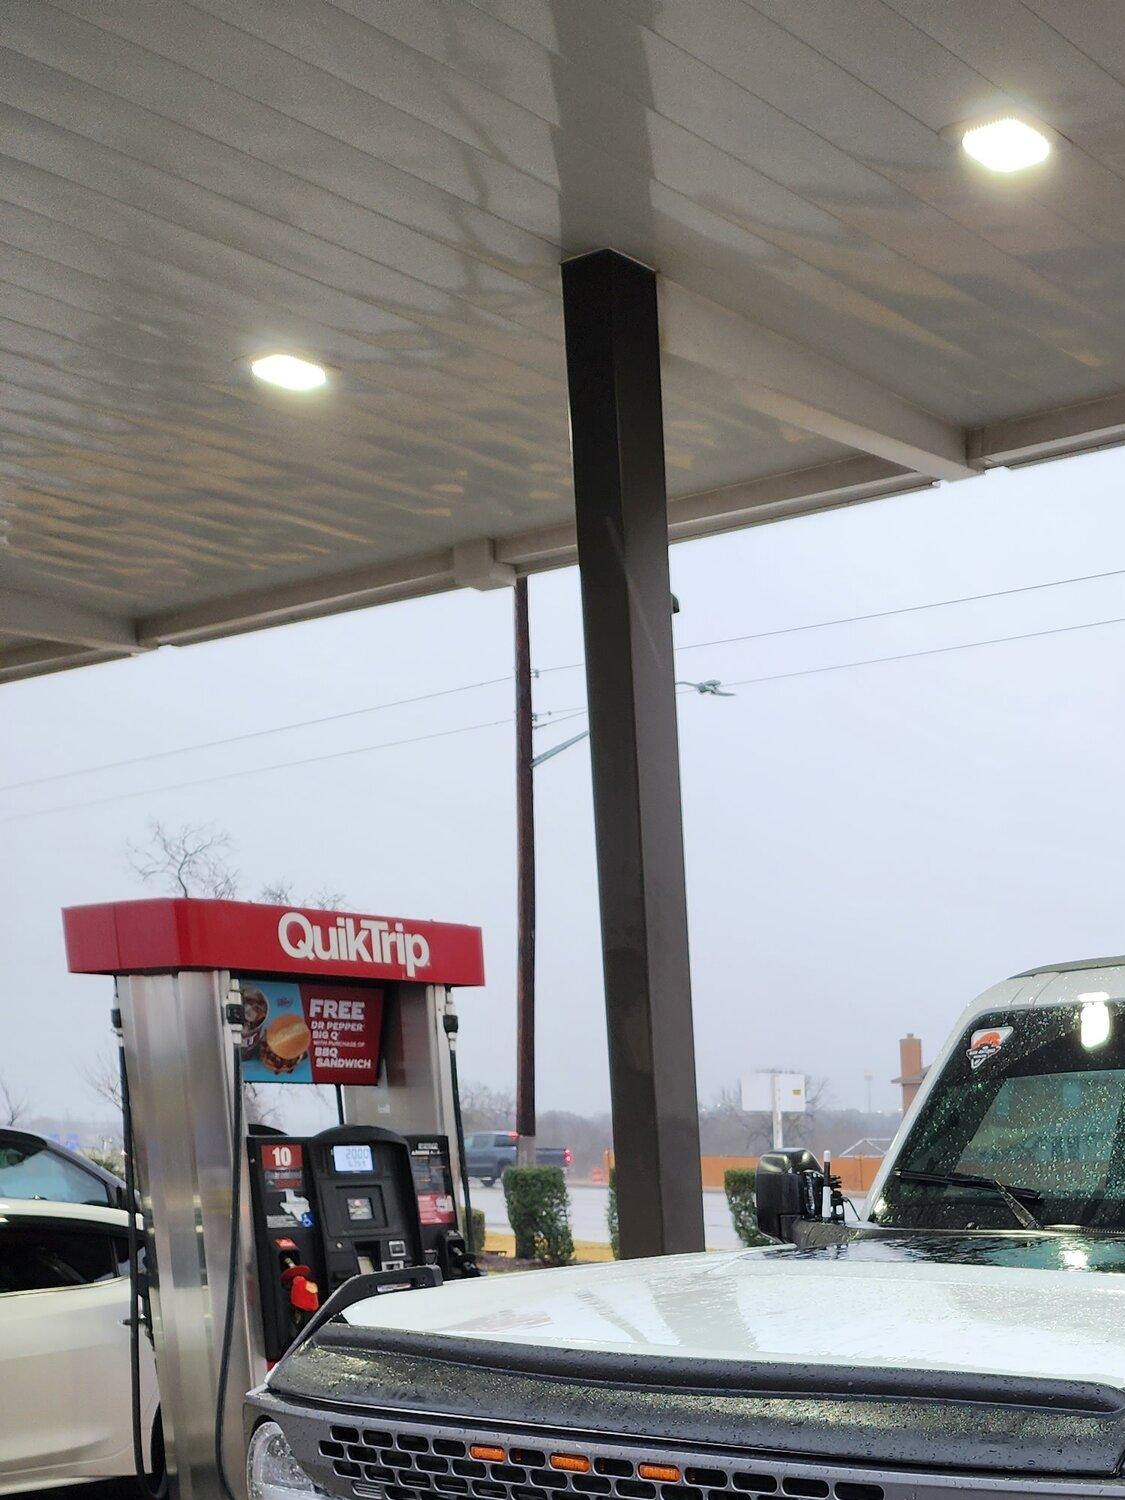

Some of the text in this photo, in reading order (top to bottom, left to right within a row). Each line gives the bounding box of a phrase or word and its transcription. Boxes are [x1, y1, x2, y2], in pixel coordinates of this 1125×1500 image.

[278, 912, 430, 978] QuikTrip
[309, 998, 365, 1020] FREE
[311, 1021, 363, 1032] DR PEPPER
[312, 1030, 339, 1041] BIG Q
[315, 1047, 338, 1058] BBQ
[316, 1058, 371, 1069] SANDWICH
[272, 1147, 292, 1167] 10
